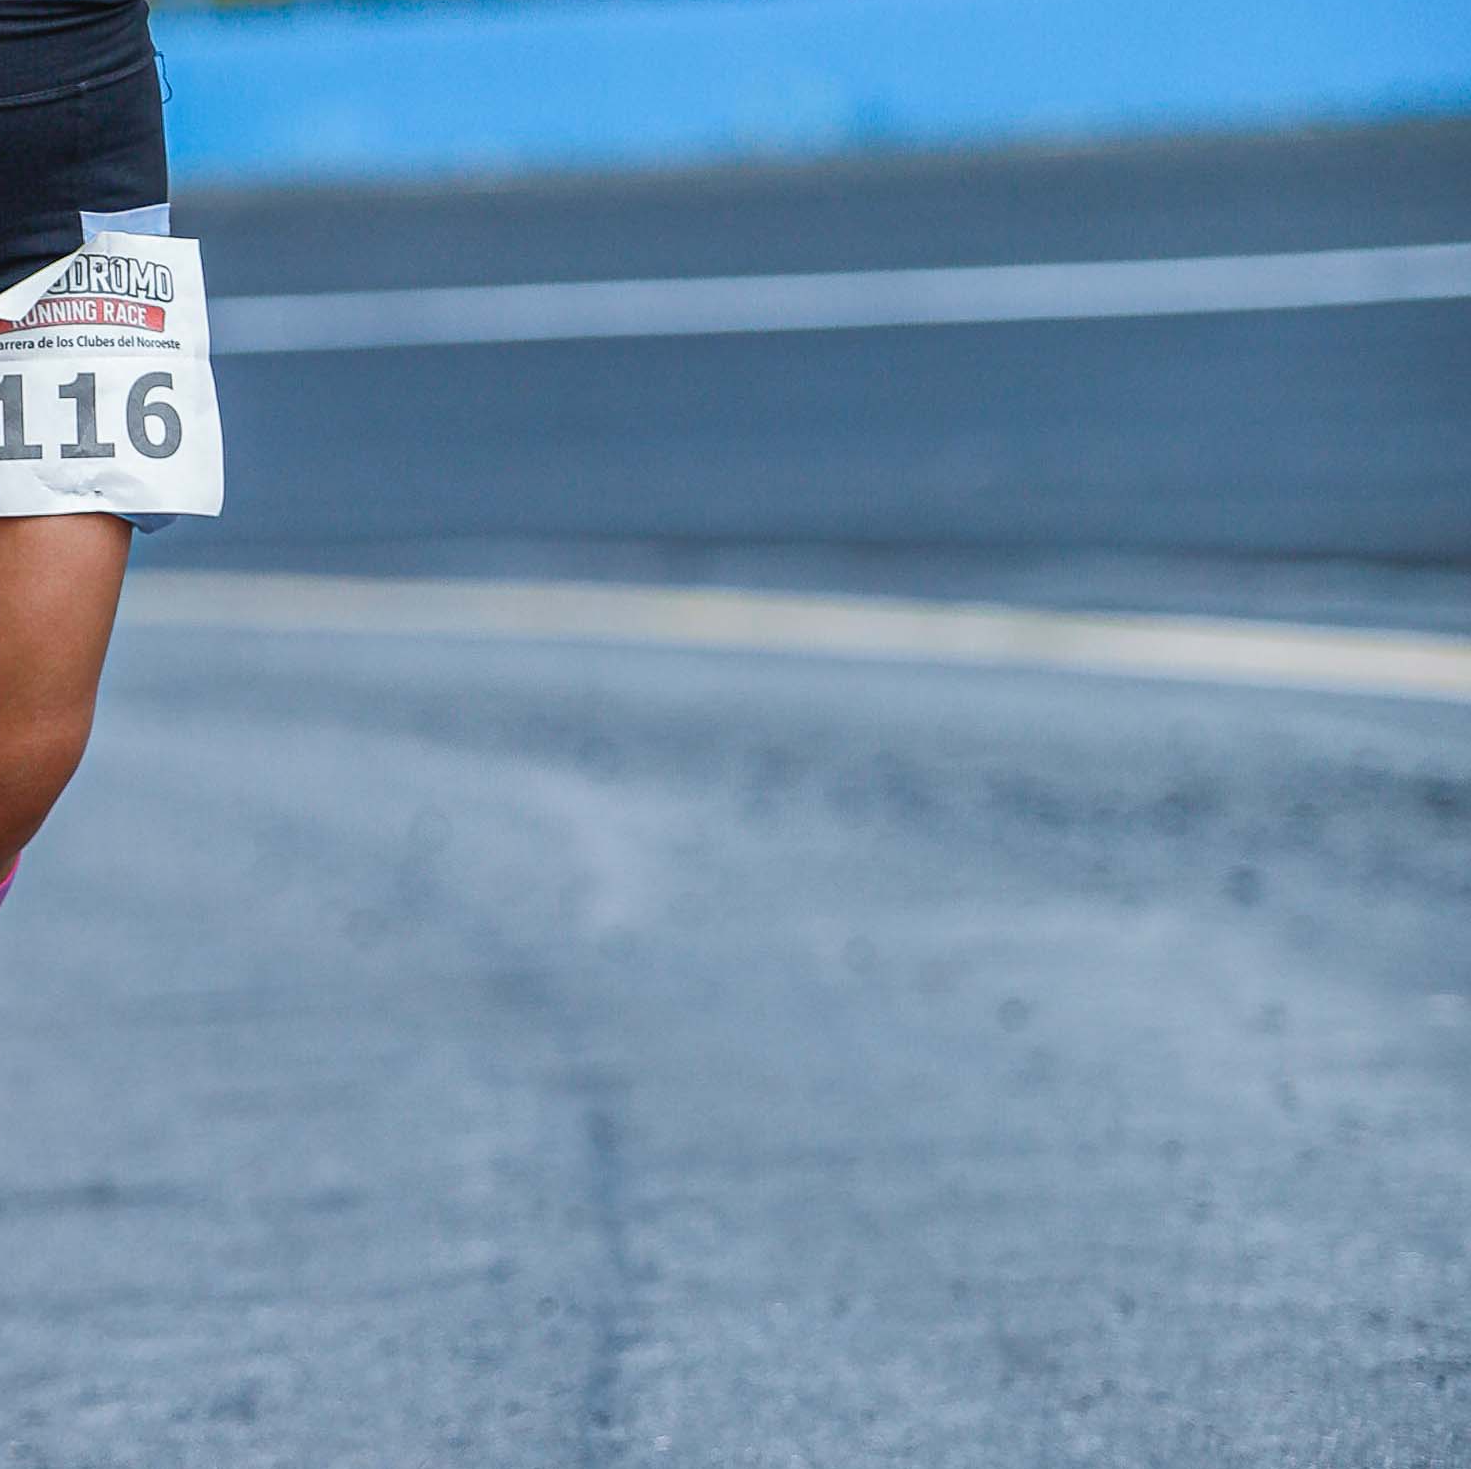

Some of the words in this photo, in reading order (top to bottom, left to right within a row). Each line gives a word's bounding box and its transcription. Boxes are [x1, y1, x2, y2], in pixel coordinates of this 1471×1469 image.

[102, 300, 148, 327] RACE
[38, 336, 54, 348] de
[56, 335, 74, 348] los
[76, 335, 115, 347] Clubes
[117, 335, 135, 347] del
[136, 336, 181, 350] Noroeste
